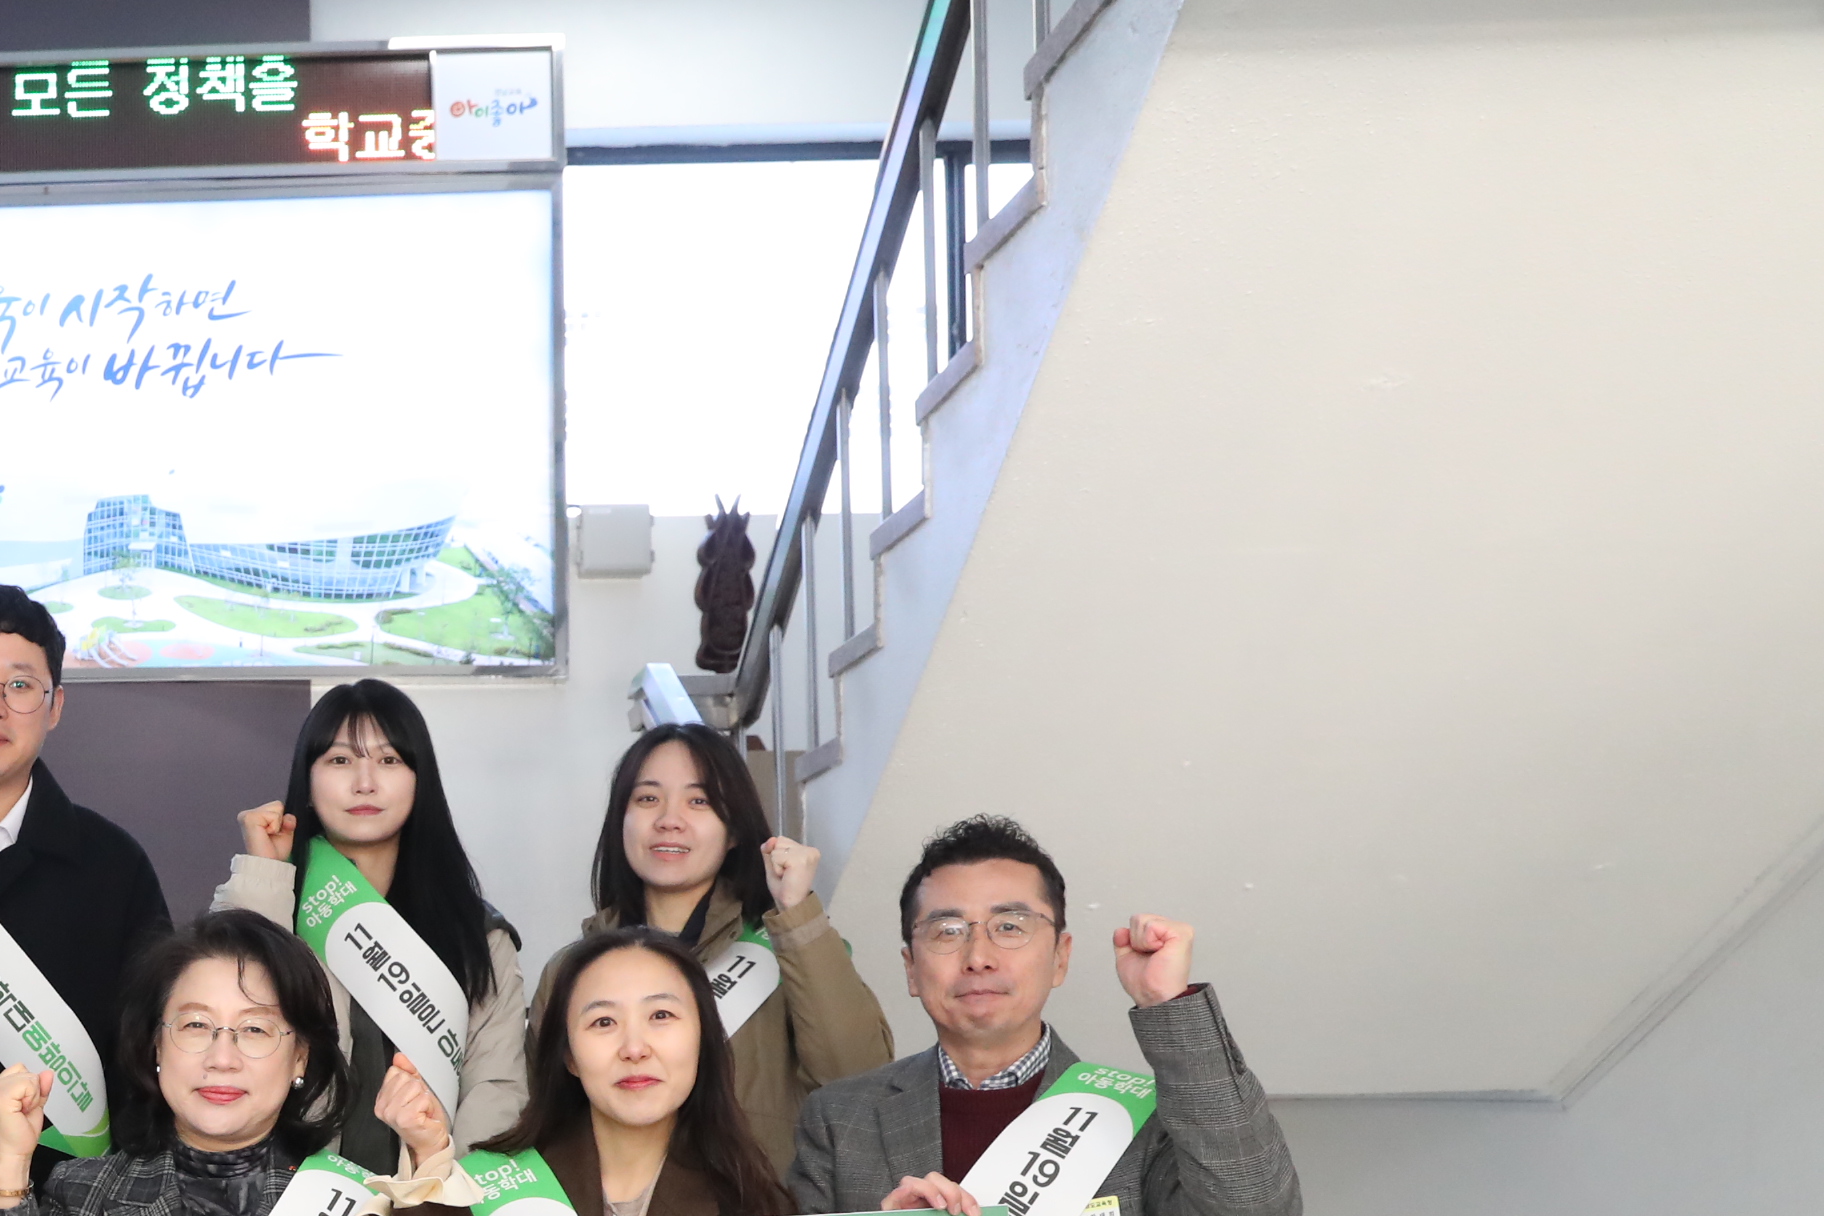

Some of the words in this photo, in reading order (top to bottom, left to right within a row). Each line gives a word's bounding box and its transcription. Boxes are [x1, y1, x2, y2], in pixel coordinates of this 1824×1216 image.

[12, 60, 113, 117] 모든
[142, 54, 298, 115] 정책을
[58, 273, 253, 344] 시작하면
[103, 337, 344, 399] 바뀝니다
[301, 875, 342, 914] stop!
[306, 880, 358, 928] 아동학대
[1078, 1072, 1154, 1099] 아동학대
[1094, 1067, 1155, 1087] stop!
